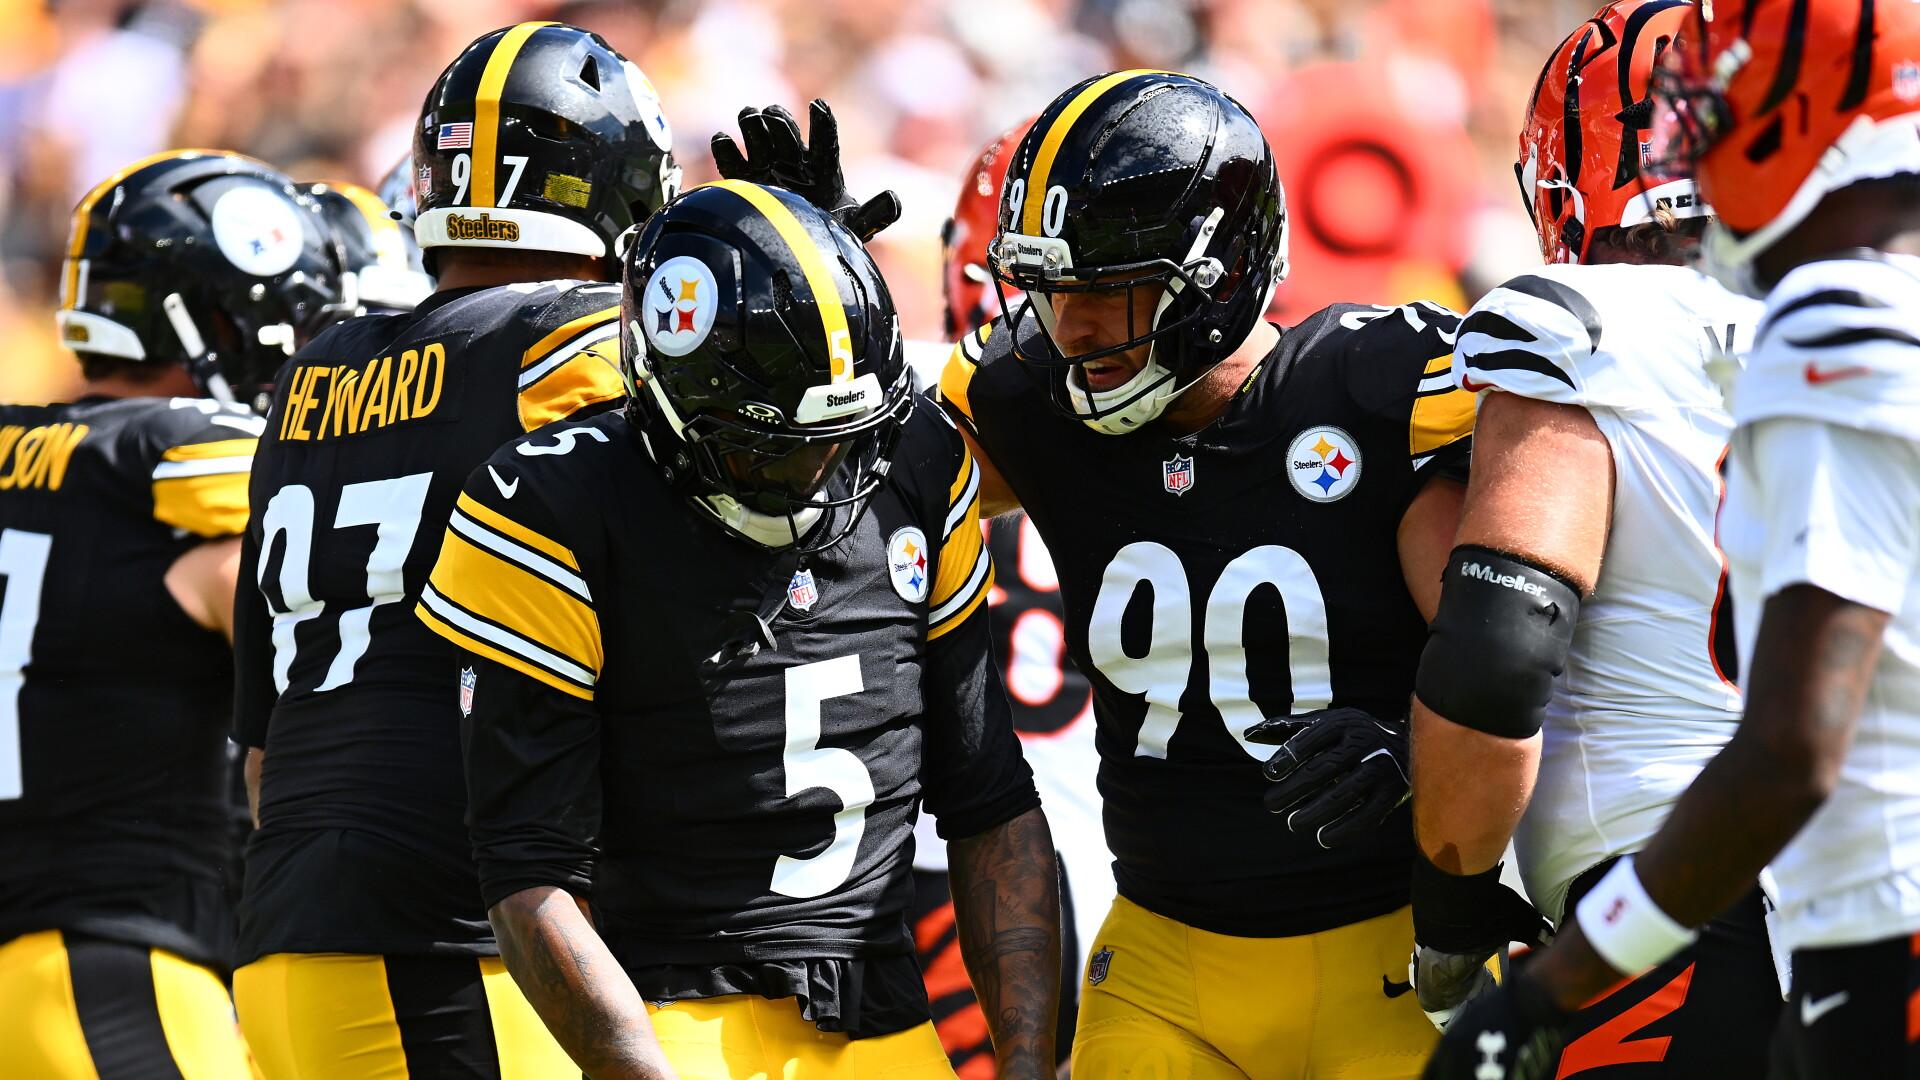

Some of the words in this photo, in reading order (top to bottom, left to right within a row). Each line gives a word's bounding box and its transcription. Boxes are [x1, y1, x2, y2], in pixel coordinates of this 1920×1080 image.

[446, 213, 520, 242] Steelers
[1017, 243, 1043, 256] Steelers
[279, 343, 446, 441] HEYWARD
[826, 390, 865, 408] Steelers
[738, 408, 781, 425] OAKLEY
[1293, 460, 1323, 470] Steelers
[1168, 471, 1189, 489] NFL
[257, 471, 434, 697] 97
[1470, 563, 1547, 598] Mueller
[791, 586, 814, 604] NFL
[1088, 541, 1333, 762] 90
[770, 654, 876, 898] 5
